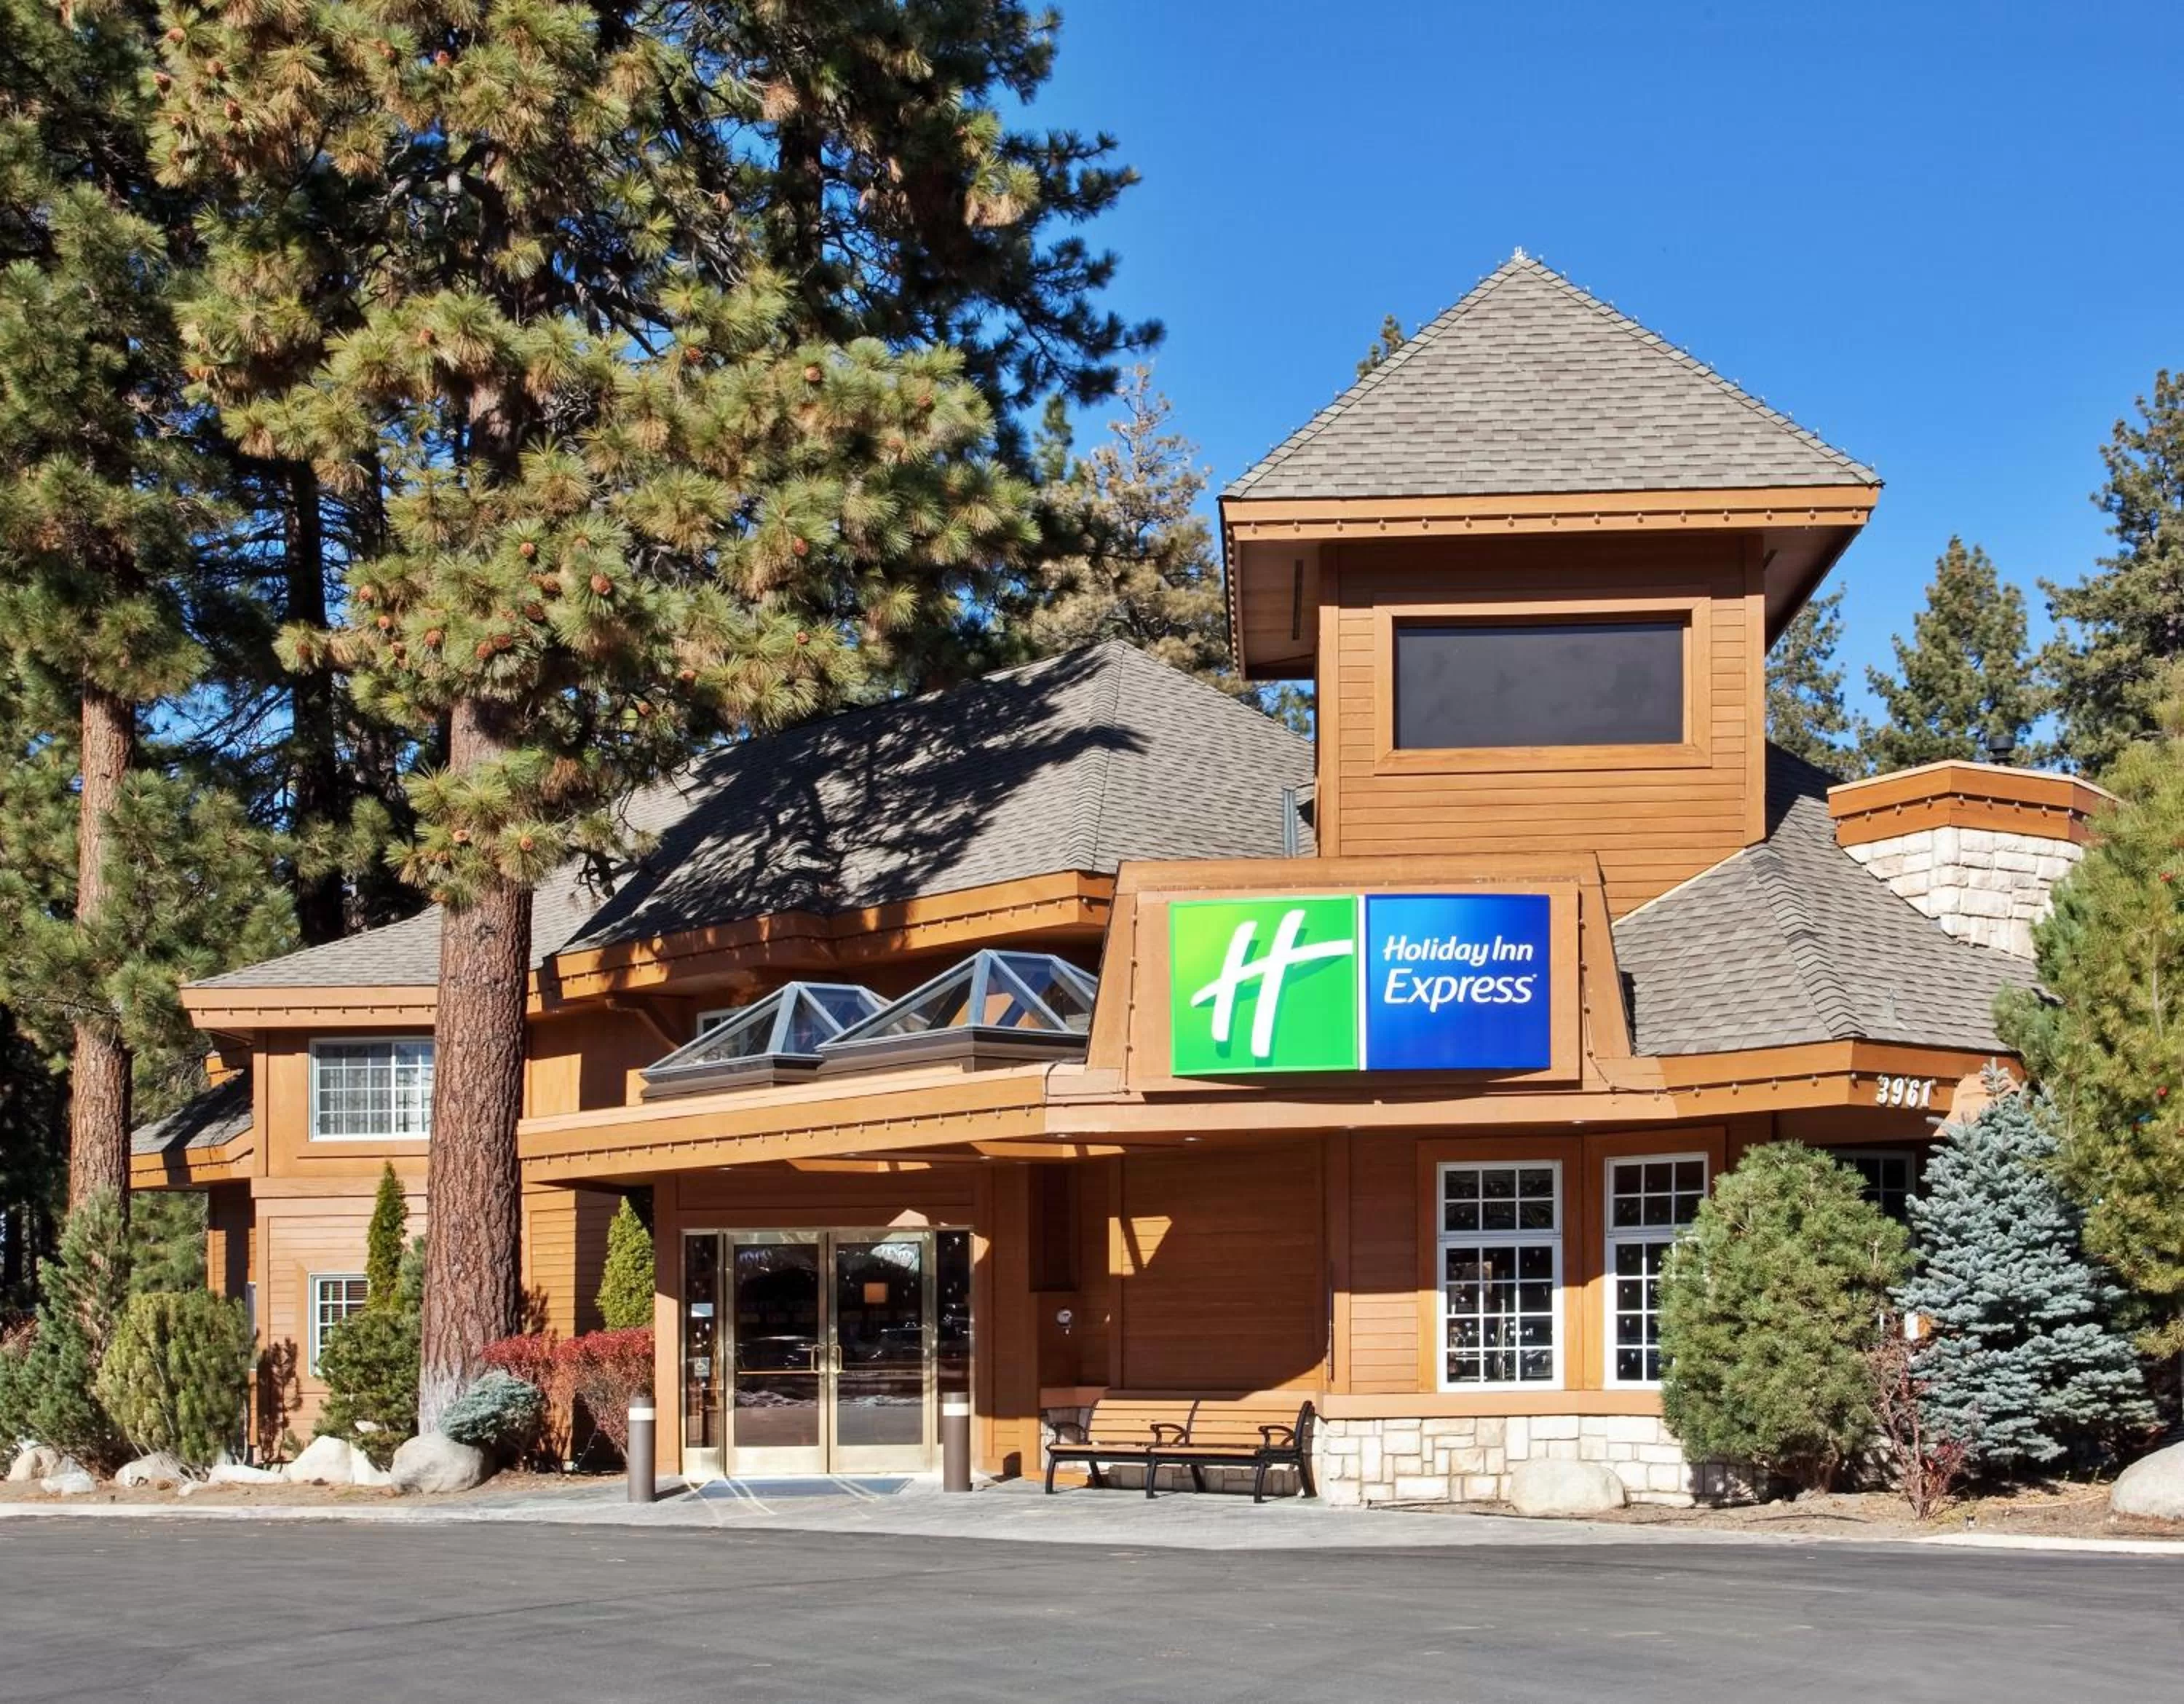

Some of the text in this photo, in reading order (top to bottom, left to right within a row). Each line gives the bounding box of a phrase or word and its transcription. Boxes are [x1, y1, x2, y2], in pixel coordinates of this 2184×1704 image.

[1382, 934, 1534, 967] Holiday Inn
[1191, 910, 1353, 1057] H
[1383, 968, 1534, 1013] Express
[1875, 1076, 1932, 1108] 3961
